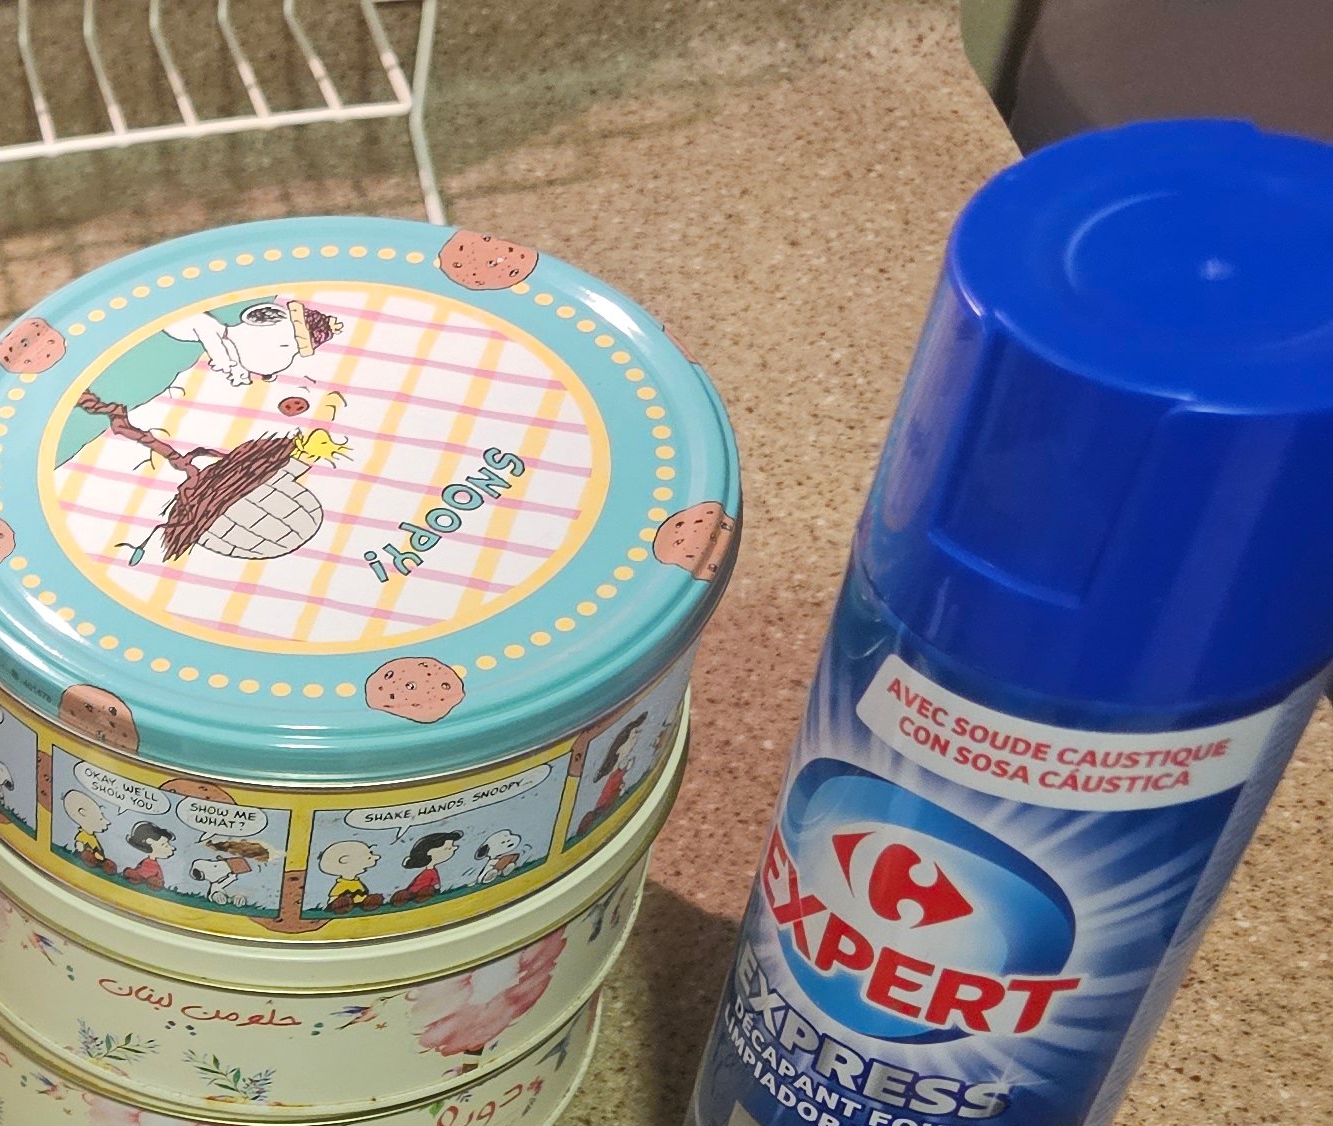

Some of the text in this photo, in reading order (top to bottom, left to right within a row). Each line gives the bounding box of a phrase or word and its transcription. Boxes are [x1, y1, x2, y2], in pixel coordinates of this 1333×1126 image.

[364, 446, 526, 584] SNOOPY!
[886, 678, 1232, 770] AVEC SOUDE CAUSTIQUE
[899, 716, 1191, 794] CON SOSA CÁUSTICA
[91, 781, 125, 801] SHOW
[123, 783, 158, 803] WE'LL
[189, 802, 257, 822] SHOW ME
[364, 811, 412, 823] SHAKE
[195, 815, 245, 831] WHAT?
[762, 825, 1081, 1034] EXPERT
[99, 978, 173, 1010] لبنان
[737, 942, 1010, 1119] EXPRESS
[735, 999, 862, 1118] DÉCAPANT
